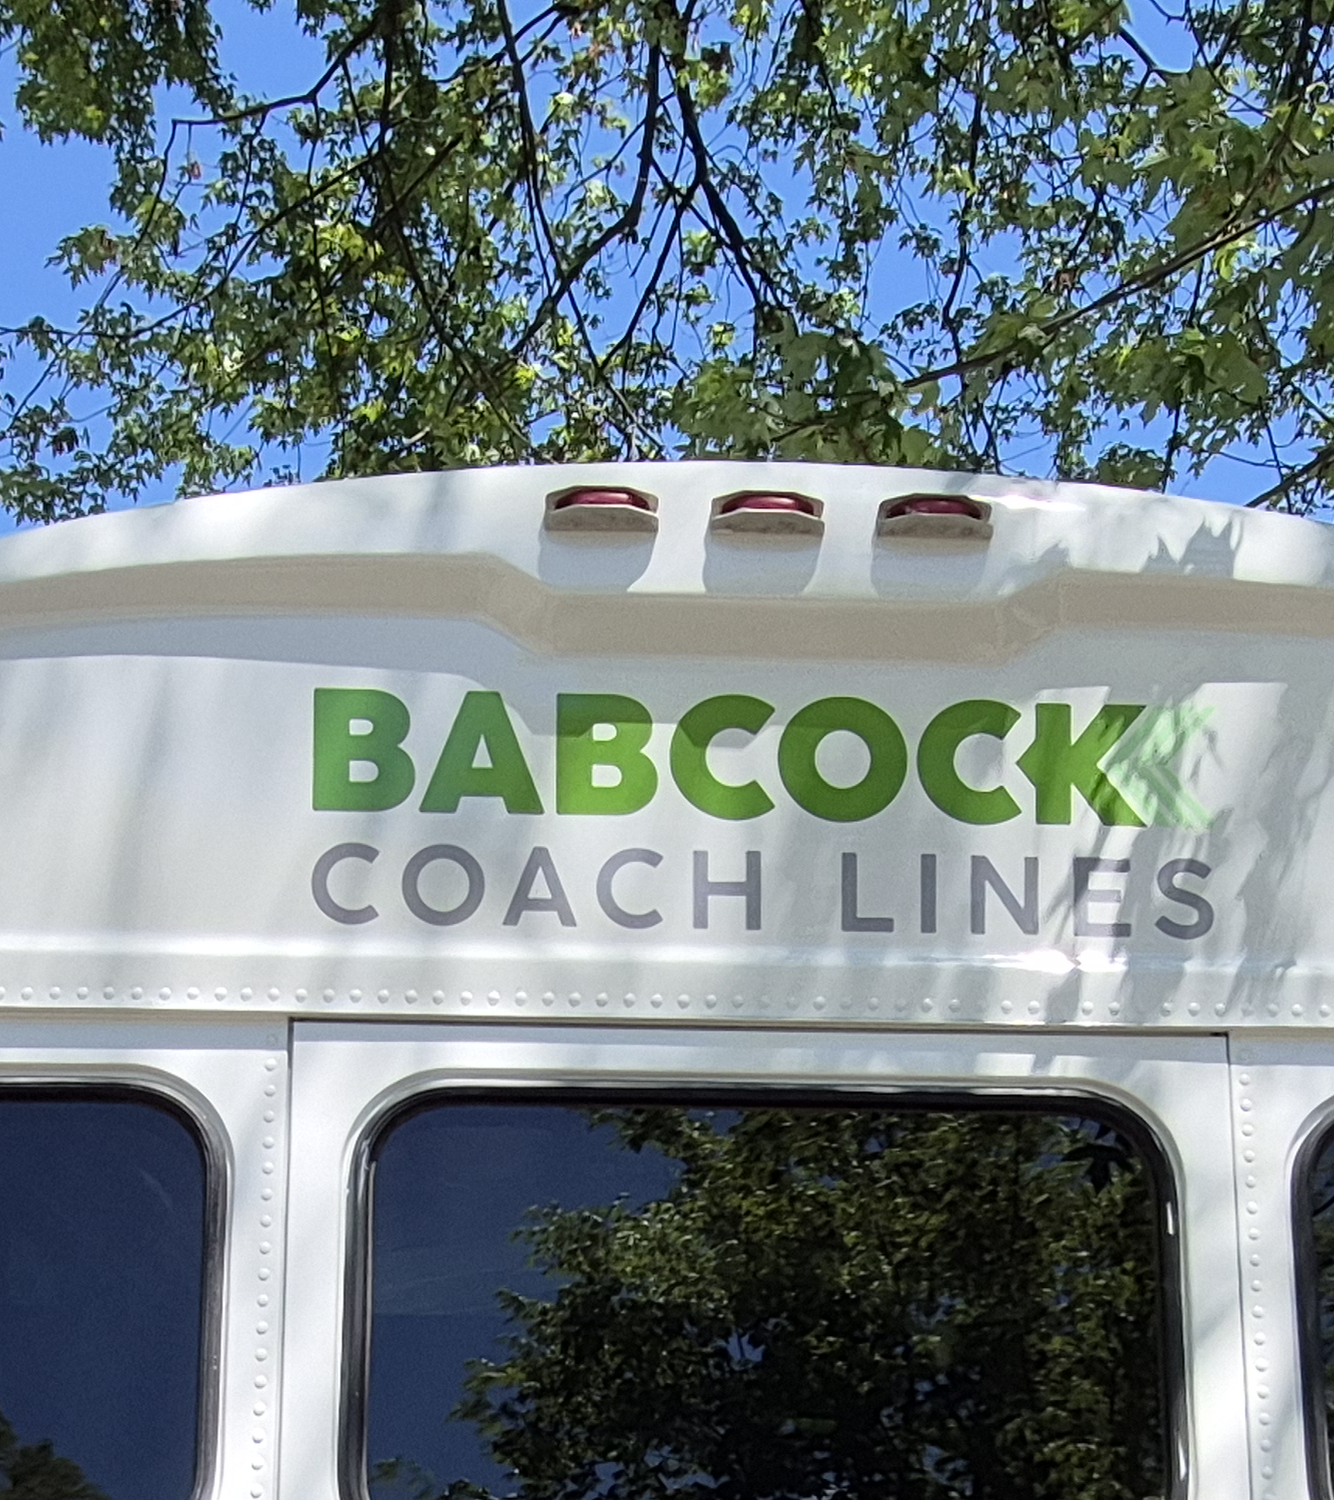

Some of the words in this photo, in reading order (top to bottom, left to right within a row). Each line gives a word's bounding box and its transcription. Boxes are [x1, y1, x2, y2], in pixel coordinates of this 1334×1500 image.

[312, 687, 1150, 827] BABCOCK
[311, 841, 762, 930] COACH
[840, 851, 1216, 940] LINES
